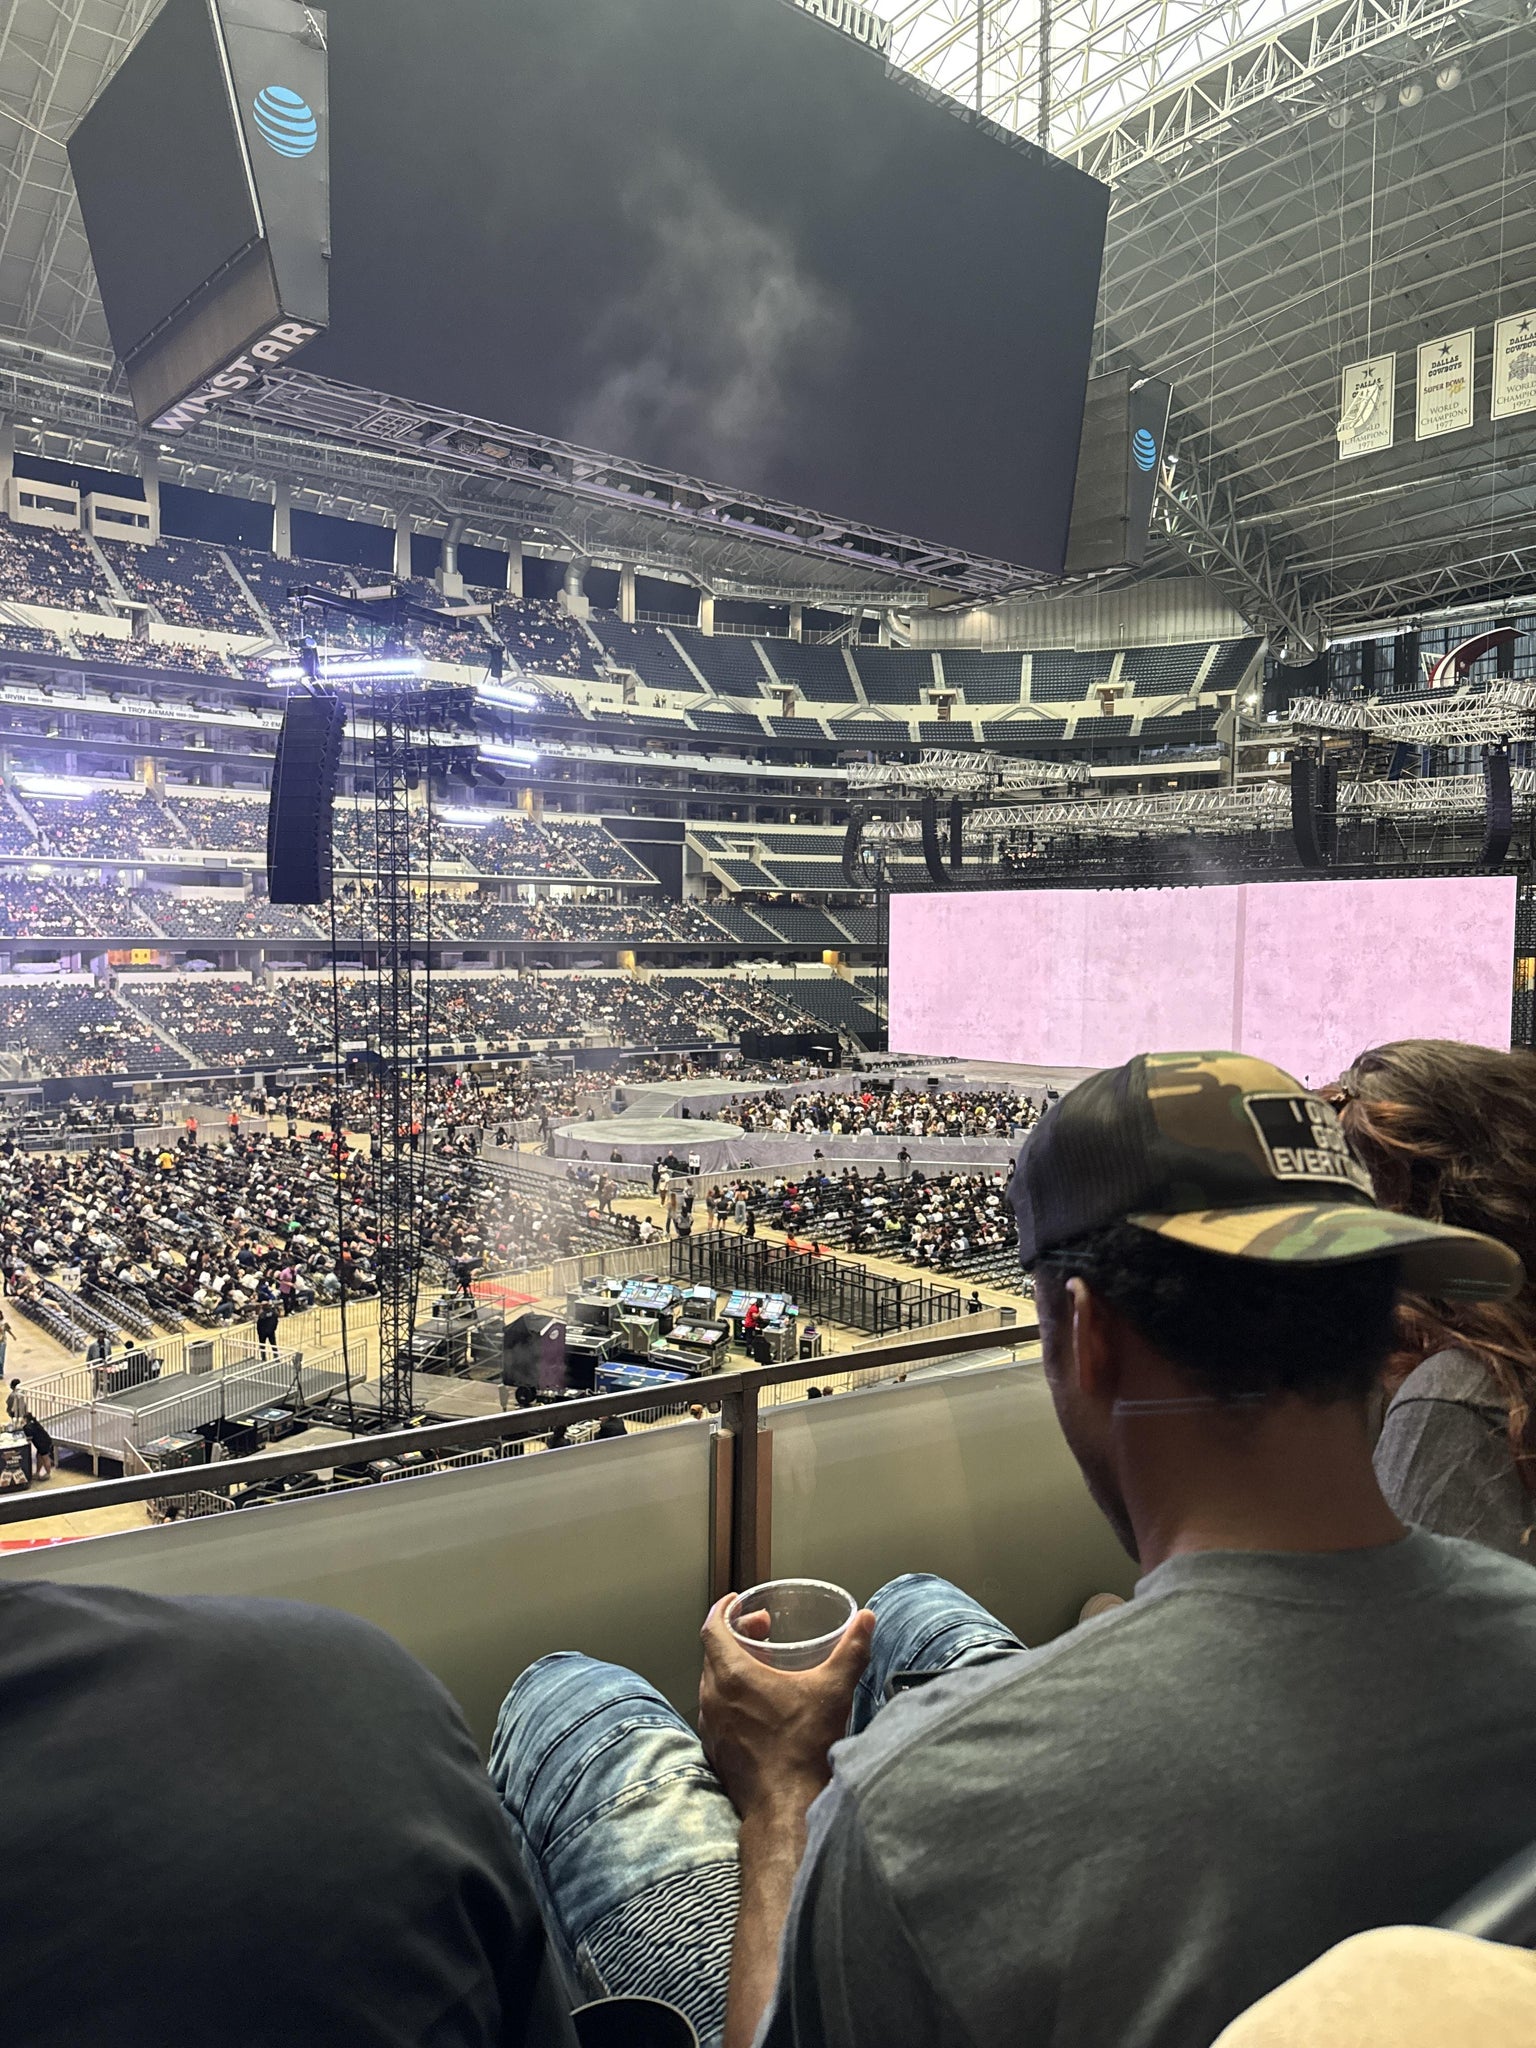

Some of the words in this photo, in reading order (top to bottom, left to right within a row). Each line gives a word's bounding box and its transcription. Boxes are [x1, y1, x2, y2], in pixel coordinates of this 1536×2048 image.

[795, 0, 893, 57] ADIUM
[1505, 340, 1536, 354] COWBOY
[1431, 355, 1459, 369] DALLAS
[151, 322, 318, 431] WINSTAR
[1428, 362, 1462, 377] COWBOYS
[1423, 383, 1444, 394] SUPER
[1446, 377, 1465, 388] BOWL
[1497, 390, 1536, 405] CHAMPIO
[1512, 399, 1531, 410] 1992
[1430, 402, 1459, 414] WORLD
[1420, 408, 1468, 426] CHAMPIONS
[1436, 419, 1453, 430] 1977
[1344, 430, 1388, 444] CHAMPIONS
[1358, 441, 1374, 450] 1971
[4, 693, 26, 701] IRVIN
[127, 706, 146, 714] TROY
[147, 708, 175, 717] AIKMAN
